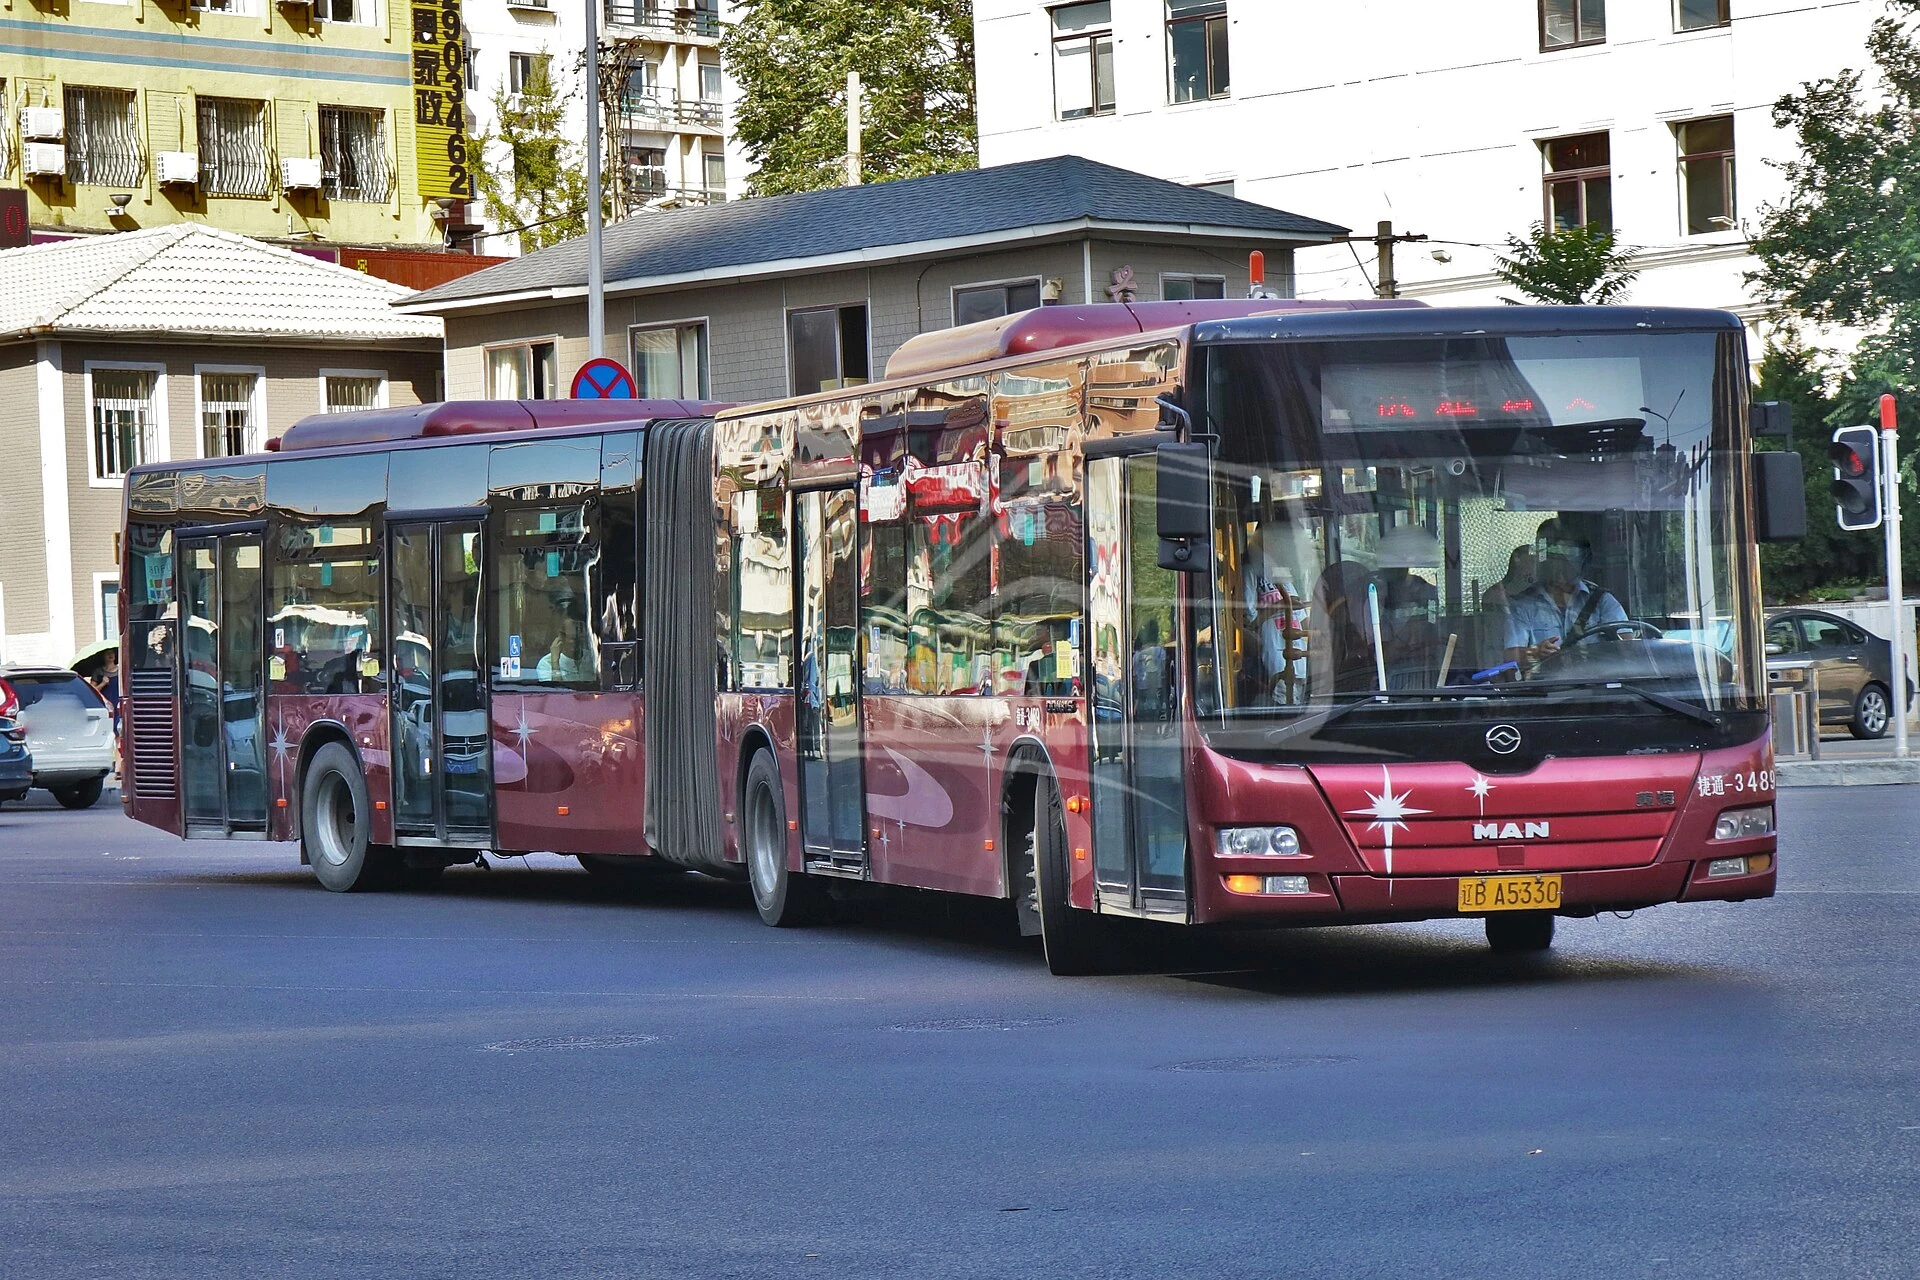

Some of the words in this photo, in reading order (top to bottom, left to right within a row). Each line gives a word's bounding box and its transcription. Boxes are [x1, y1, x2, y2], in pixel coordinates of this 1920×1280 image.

[412, 0, 444, 126] 恩家政
[1697, 770, 1776, 797] 捷通-3489
[1472, 821, 1550, 840] MAN
[1461, 883, 1487, 906] 辽B
[1494, 880, 1559, 906] A5330
